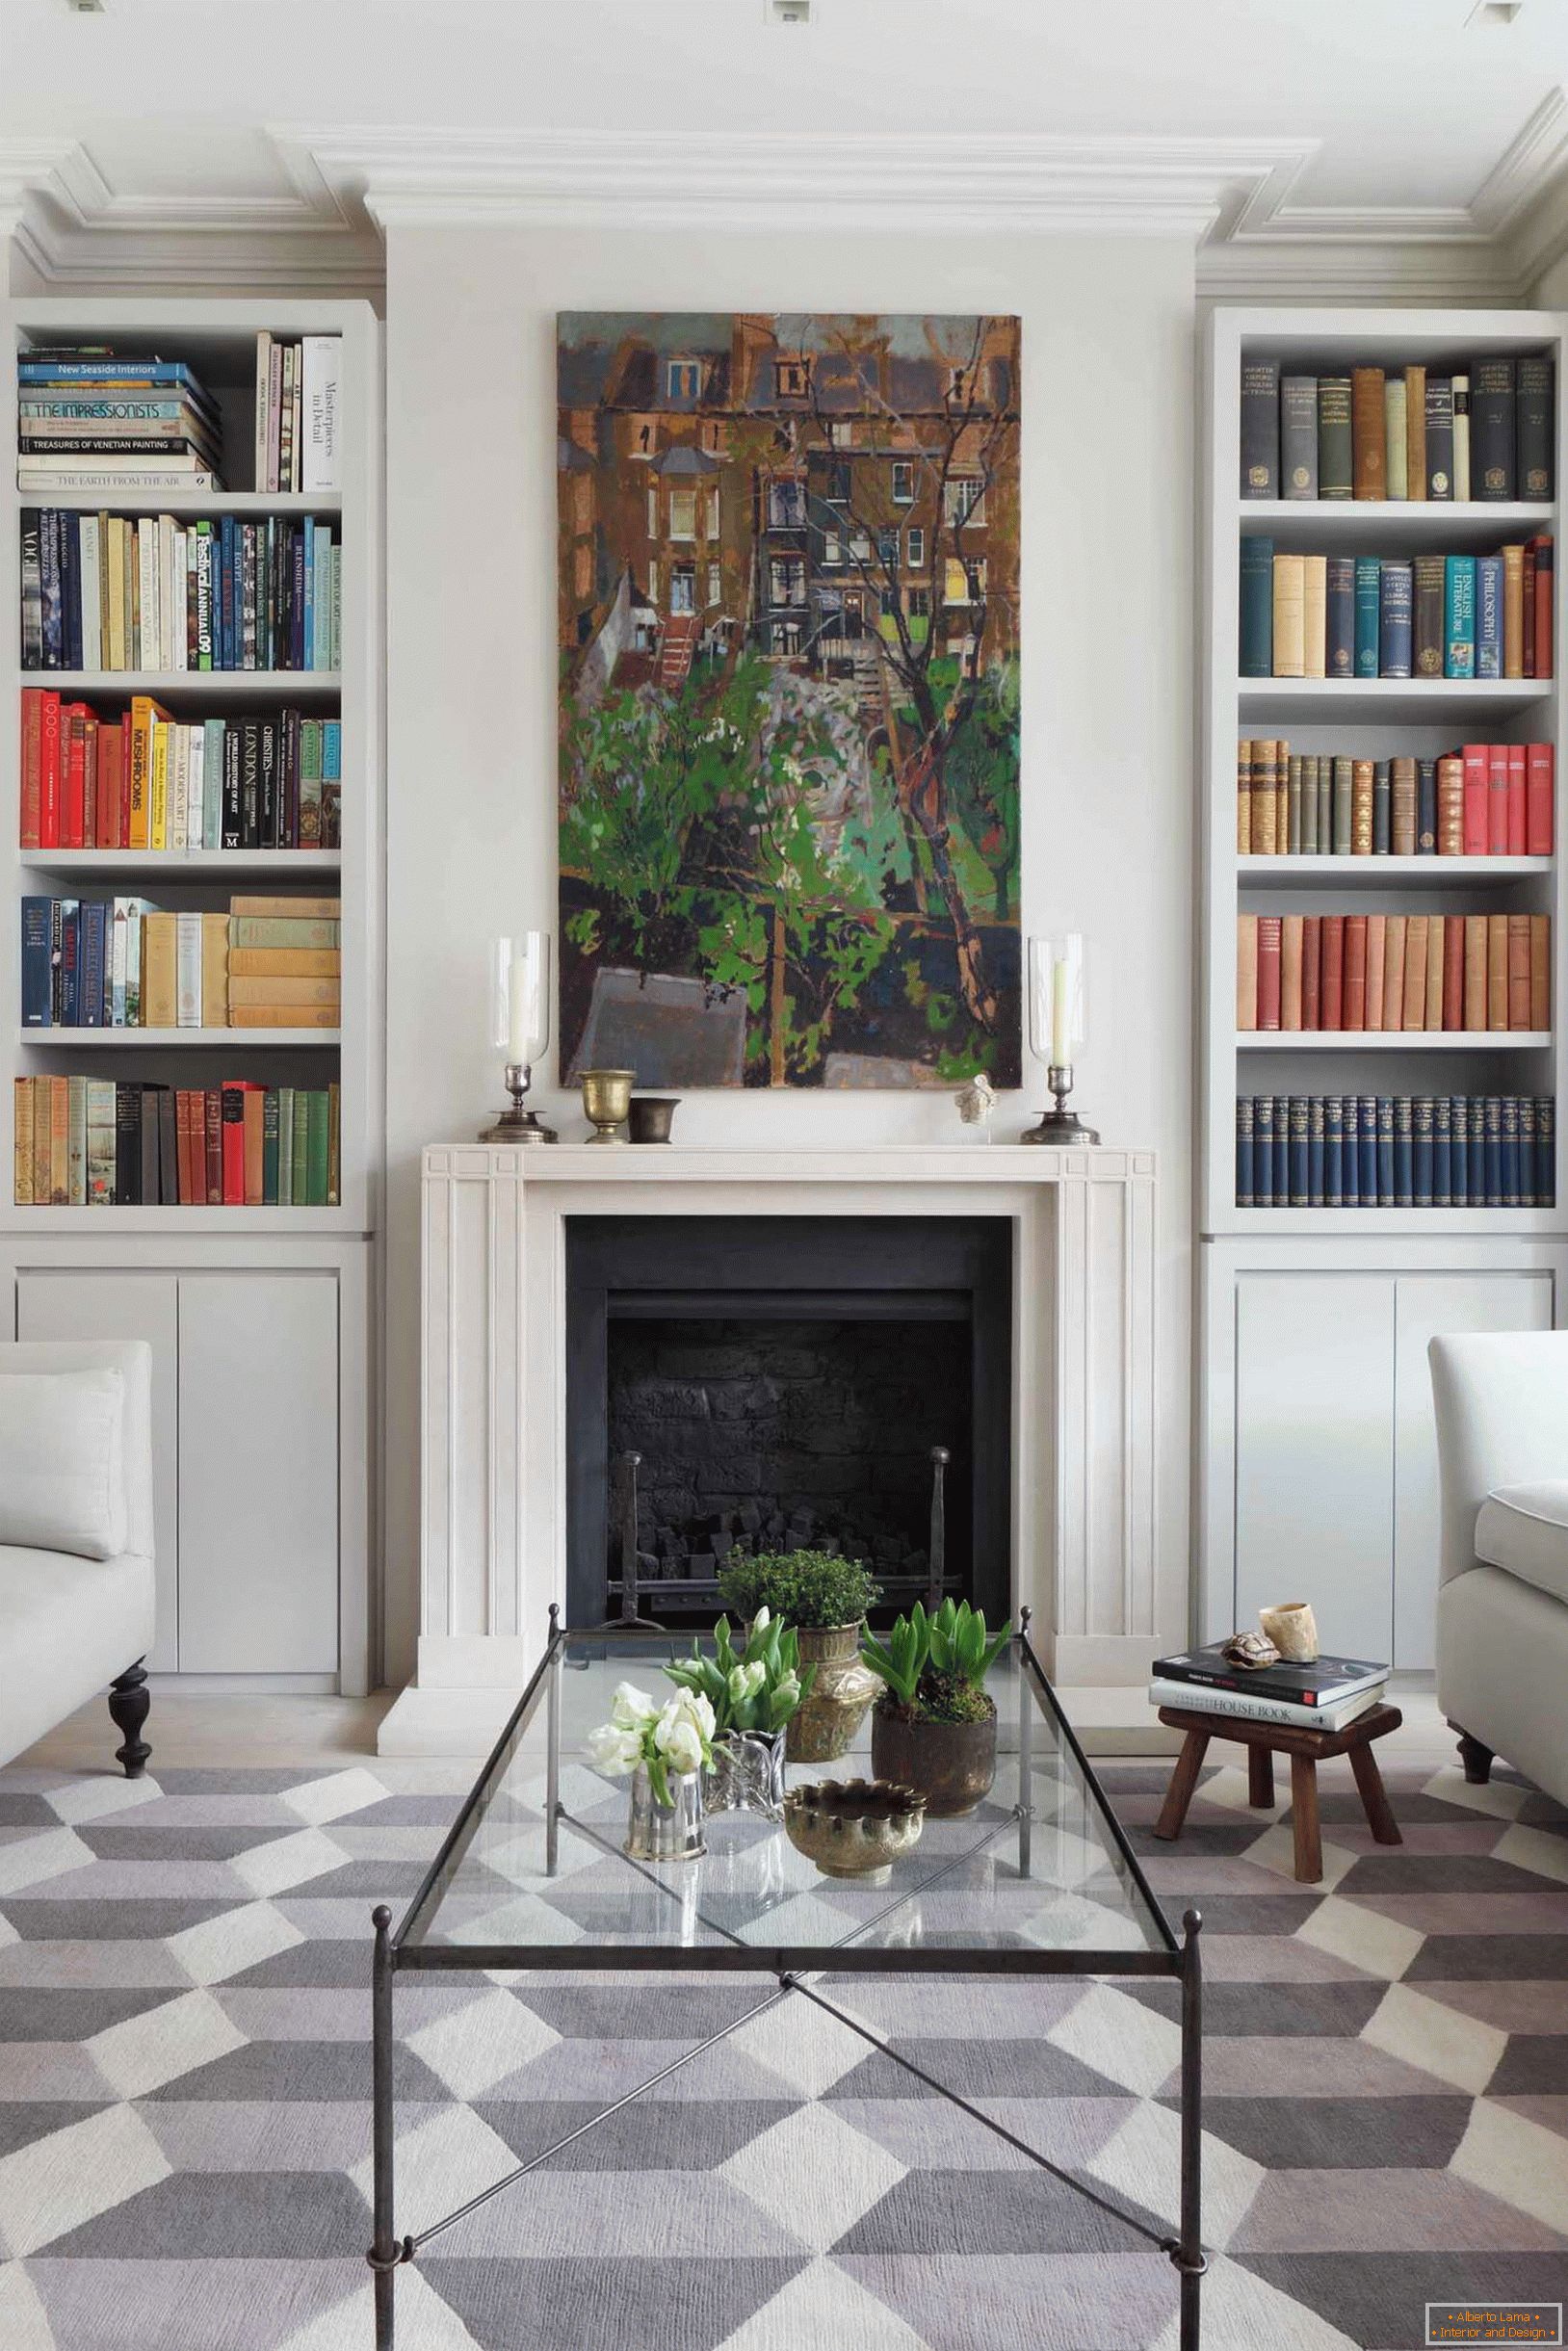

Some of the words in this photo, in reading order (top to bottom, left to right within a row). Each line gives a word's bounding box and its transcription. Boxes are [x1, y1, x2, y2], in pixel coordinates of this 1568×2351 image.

[58, 364, 80, 374] New
[81, 364, 117, 374] Seaside
[118, 364, 157, 375] Interiors
[313, 395, 324, 405] in
[323, 381, 337, 457] Masterpieces
[34, 440, 79, 450] TREASURES
[81, 440, 91, 449] OF
[93, 440, 131, 449] VENETIAN
[133, 440, 169, 449] PAINTING
[313, 409, 324, 443] Detail
[57, 477, 77, 486] THE
[79, 477, 111, 486] EARTH
[113, 477, 142, 486] FROM
[144, 477, 163, 486] THE
[197, 536, 211, 588] Festival
[197, 588, 209, 635] ANNUAL
[1452, 574, 1462, 632] LITERATURE
[1462, 574, 1472, 618] ENGLISH
[1483, 571, 1496, 640] PHILOSOPHY
[198, 636, 211, 653] 09
[132, 729, 144, 810] MUSHROOMS
[245, 726, 257, 785] LONDON
[1214, 1698, 1254, 1715] HOUSE
[1257, 1706, 1293, 1722] BOOK
